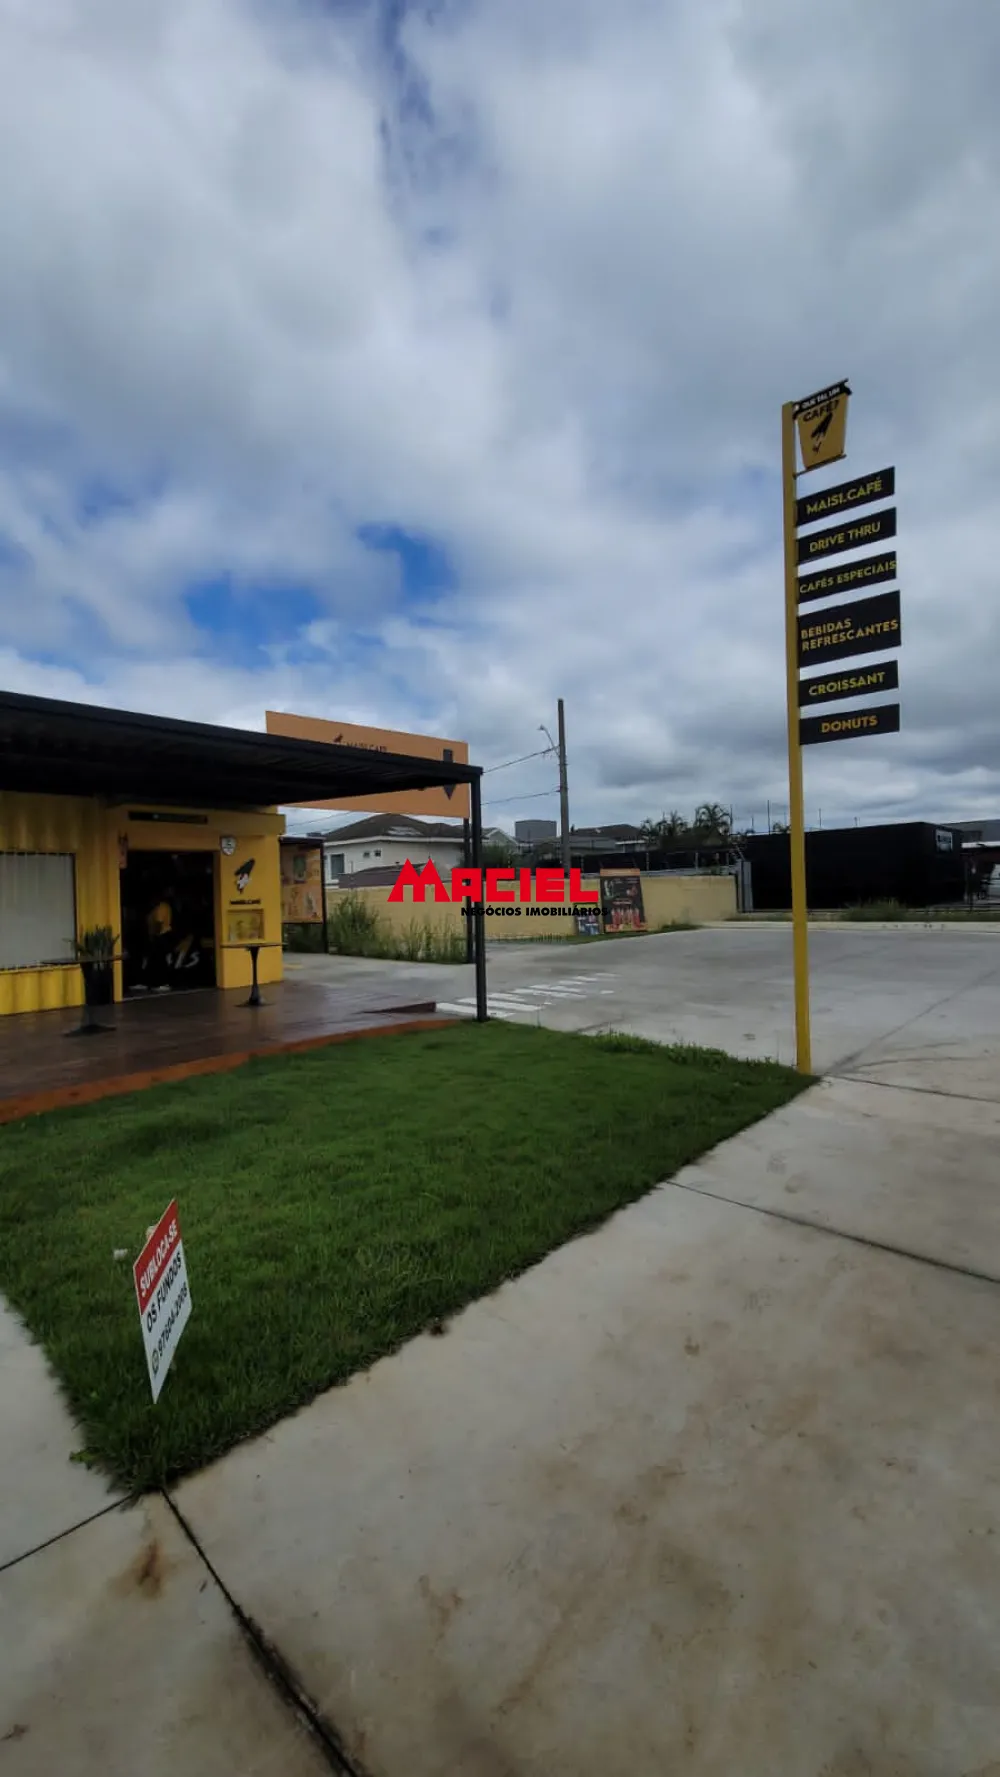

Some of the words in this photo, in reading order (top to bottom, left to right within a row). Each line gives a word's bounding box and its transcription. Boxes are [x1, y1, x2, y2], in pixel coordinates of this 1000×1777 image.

[809, 533, 845, 553] DRIVE
[848, 521, 881, 541] THRU
[799, 577, 834, 594] CAFÉS
[836, 560, 897, 584] ESPECIAIS
[801, 618, 852, 640] BEBIDAS
[801, 619, 899, 652] REFRESCANTES
[808, 671, 886, 696] CROISSANT
[821, 715, 878, 733] DONUTS
[147, 1303, 157, 1333] OS
[157, 1252, 182, 1312] FUNDOS
